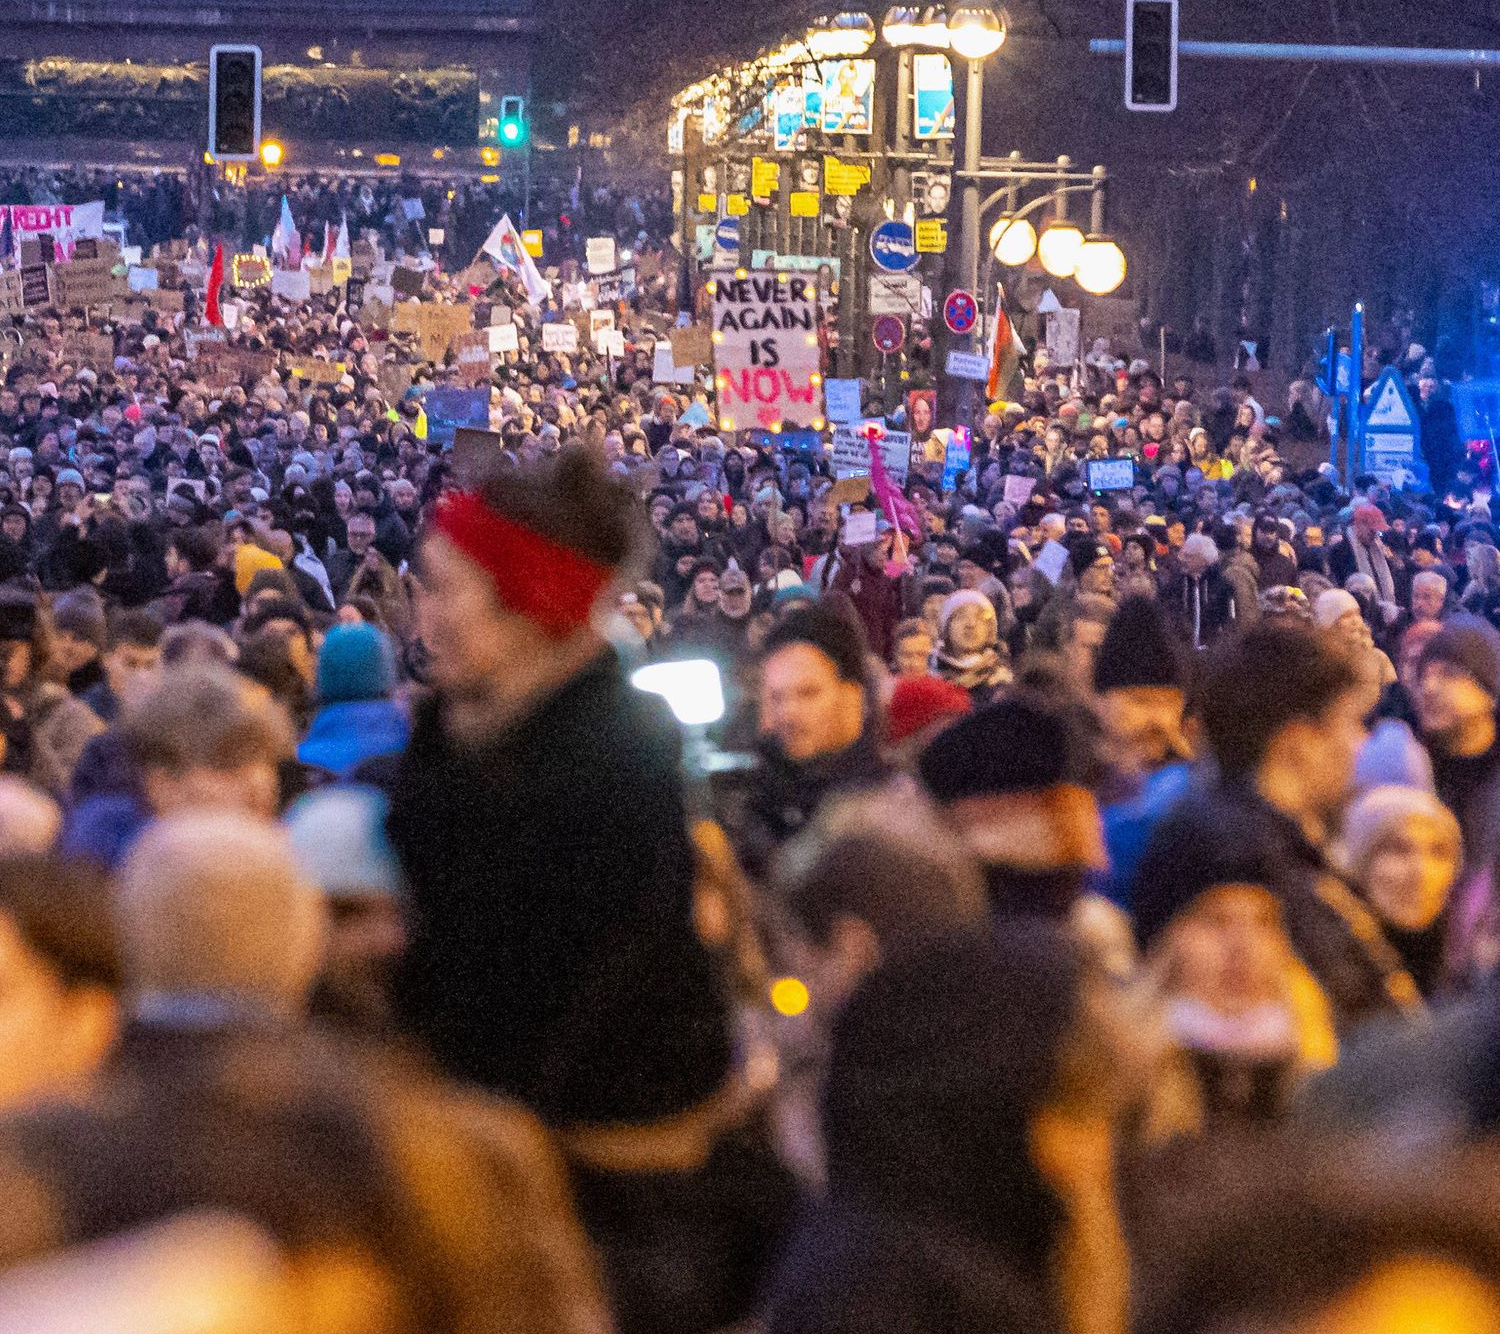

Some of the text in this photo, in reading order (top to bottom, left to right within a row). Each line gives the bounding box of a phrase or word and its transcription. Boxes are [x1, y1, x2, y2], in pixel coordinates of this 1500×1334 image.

[715, 277, 810, 303] NEVER
[719, 306, 814, 332] AGAIN
[750, 337, 780, 367] IS
[720, 367, 815, 405] NOW
